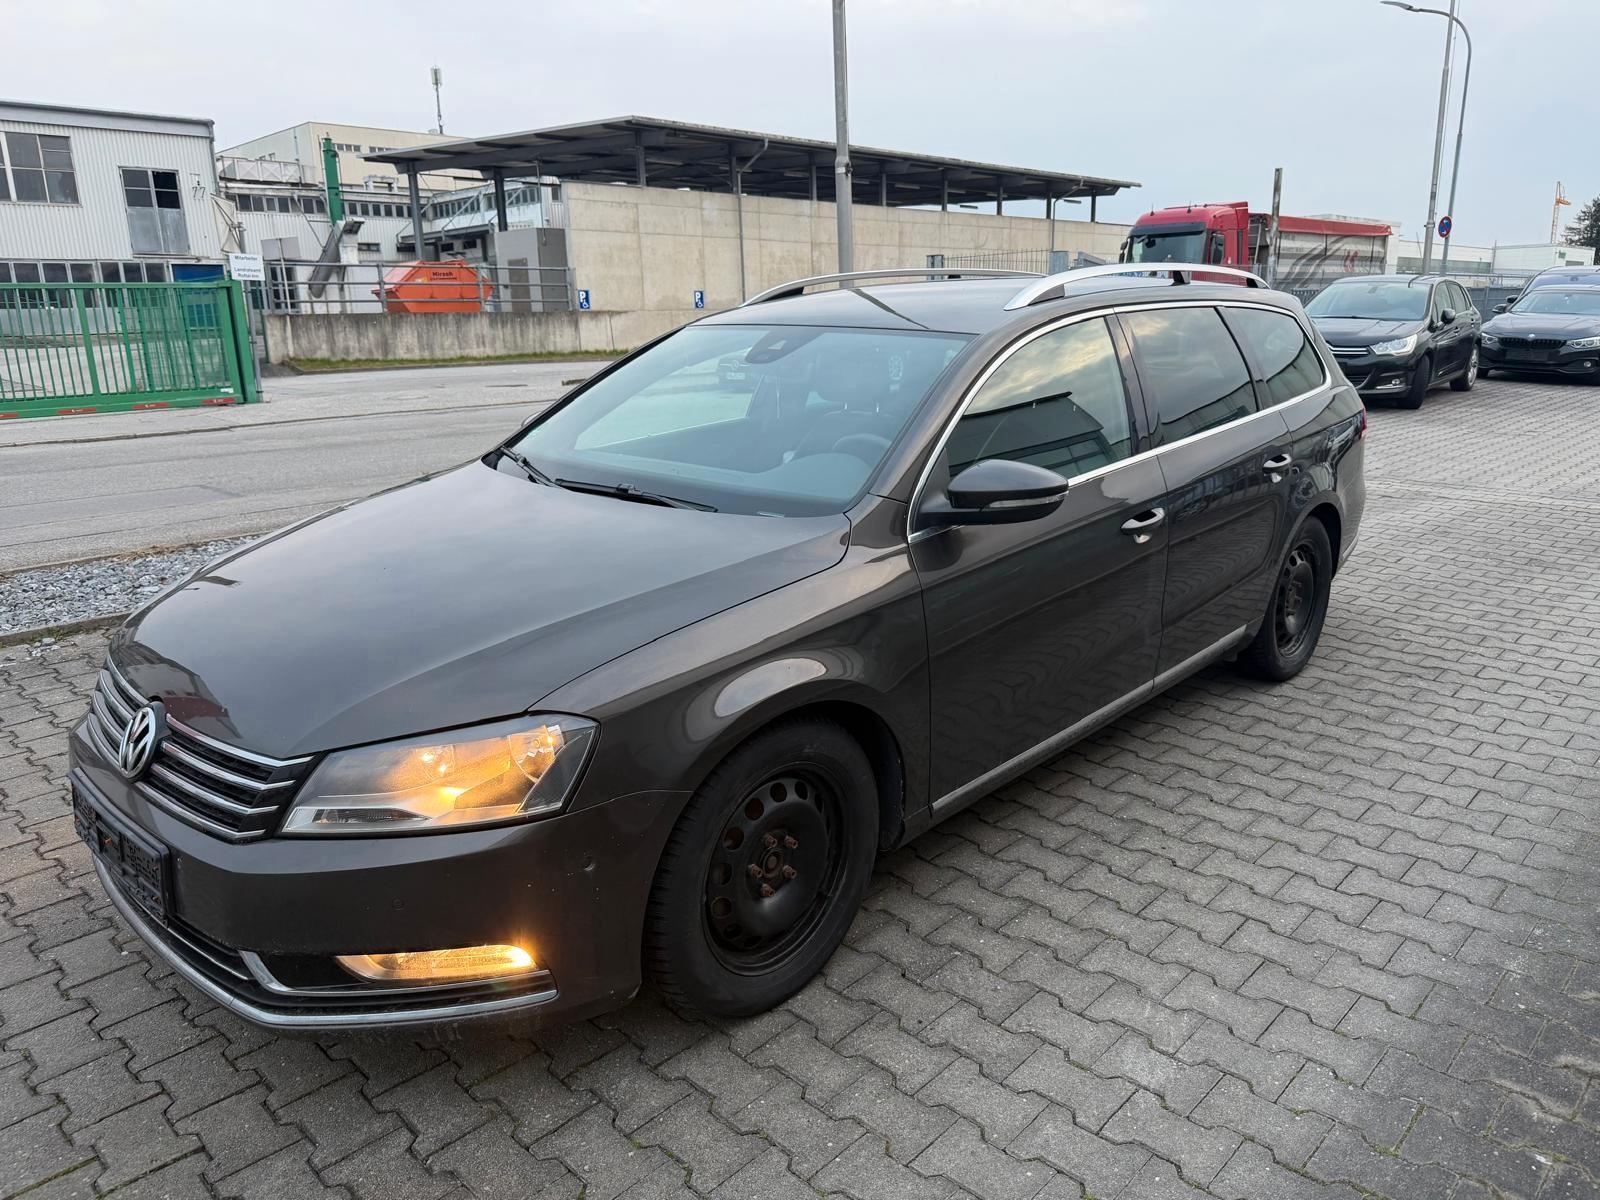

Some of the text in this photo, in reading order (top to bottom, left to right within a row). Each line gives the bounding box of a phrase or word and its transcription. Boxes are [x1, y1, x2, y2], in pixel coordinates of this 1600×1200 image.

[192, 186, 206, 199] 77
[579, 291, 586, 302] P
[695, 292, 701, 302] P
